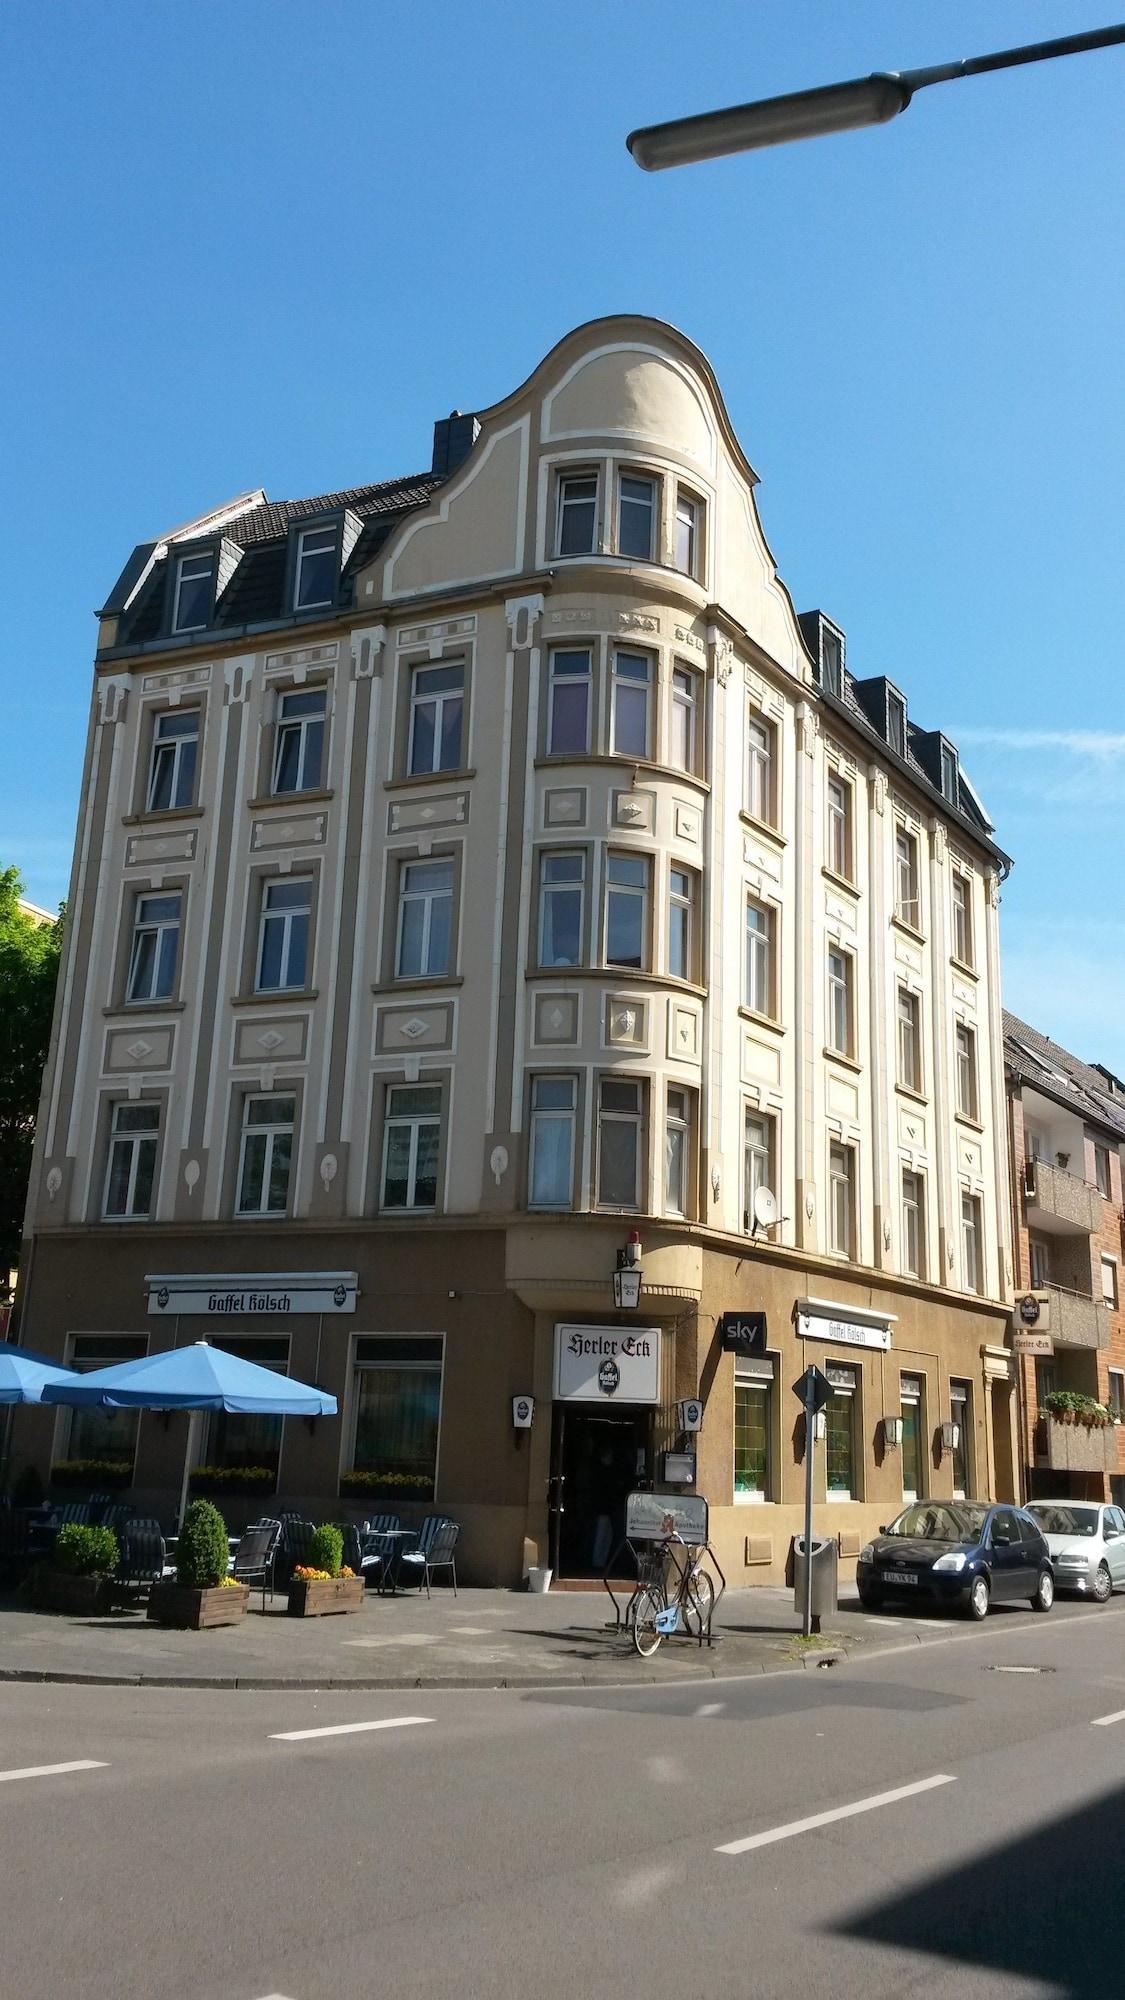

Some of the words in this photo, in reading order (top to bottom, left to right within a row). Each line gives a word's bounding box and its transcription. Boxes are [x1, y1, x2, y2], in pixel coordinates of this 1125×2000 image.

[208, 1294, 244, 1312] Gaffel
[249, 1294, 290, 1312] Kölsch
[727, 1320, 758, 1343] sky
[828, 1321, 846, 1339] Gaffel
[847, 1325, 866, 1344] Kölsch
[567, 1333, 618, 1358] Herler
[621, 1336, 650, 1357] Eck
